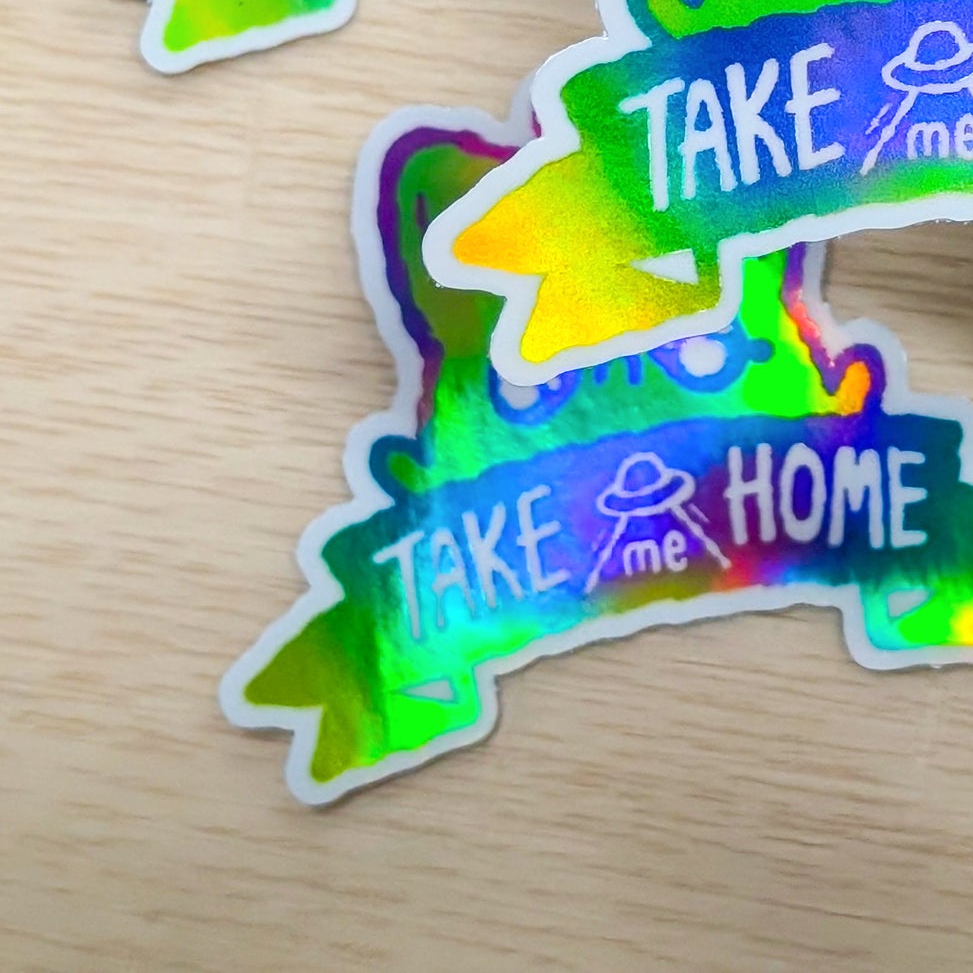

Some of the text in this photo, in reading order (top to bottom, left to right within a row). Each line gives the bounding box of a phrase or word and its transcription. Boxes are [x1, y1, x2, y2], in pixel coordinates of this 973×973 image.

[619, 42, 845, 211] TAKE
[373, 442, 928, 640] TAKE me HOME
